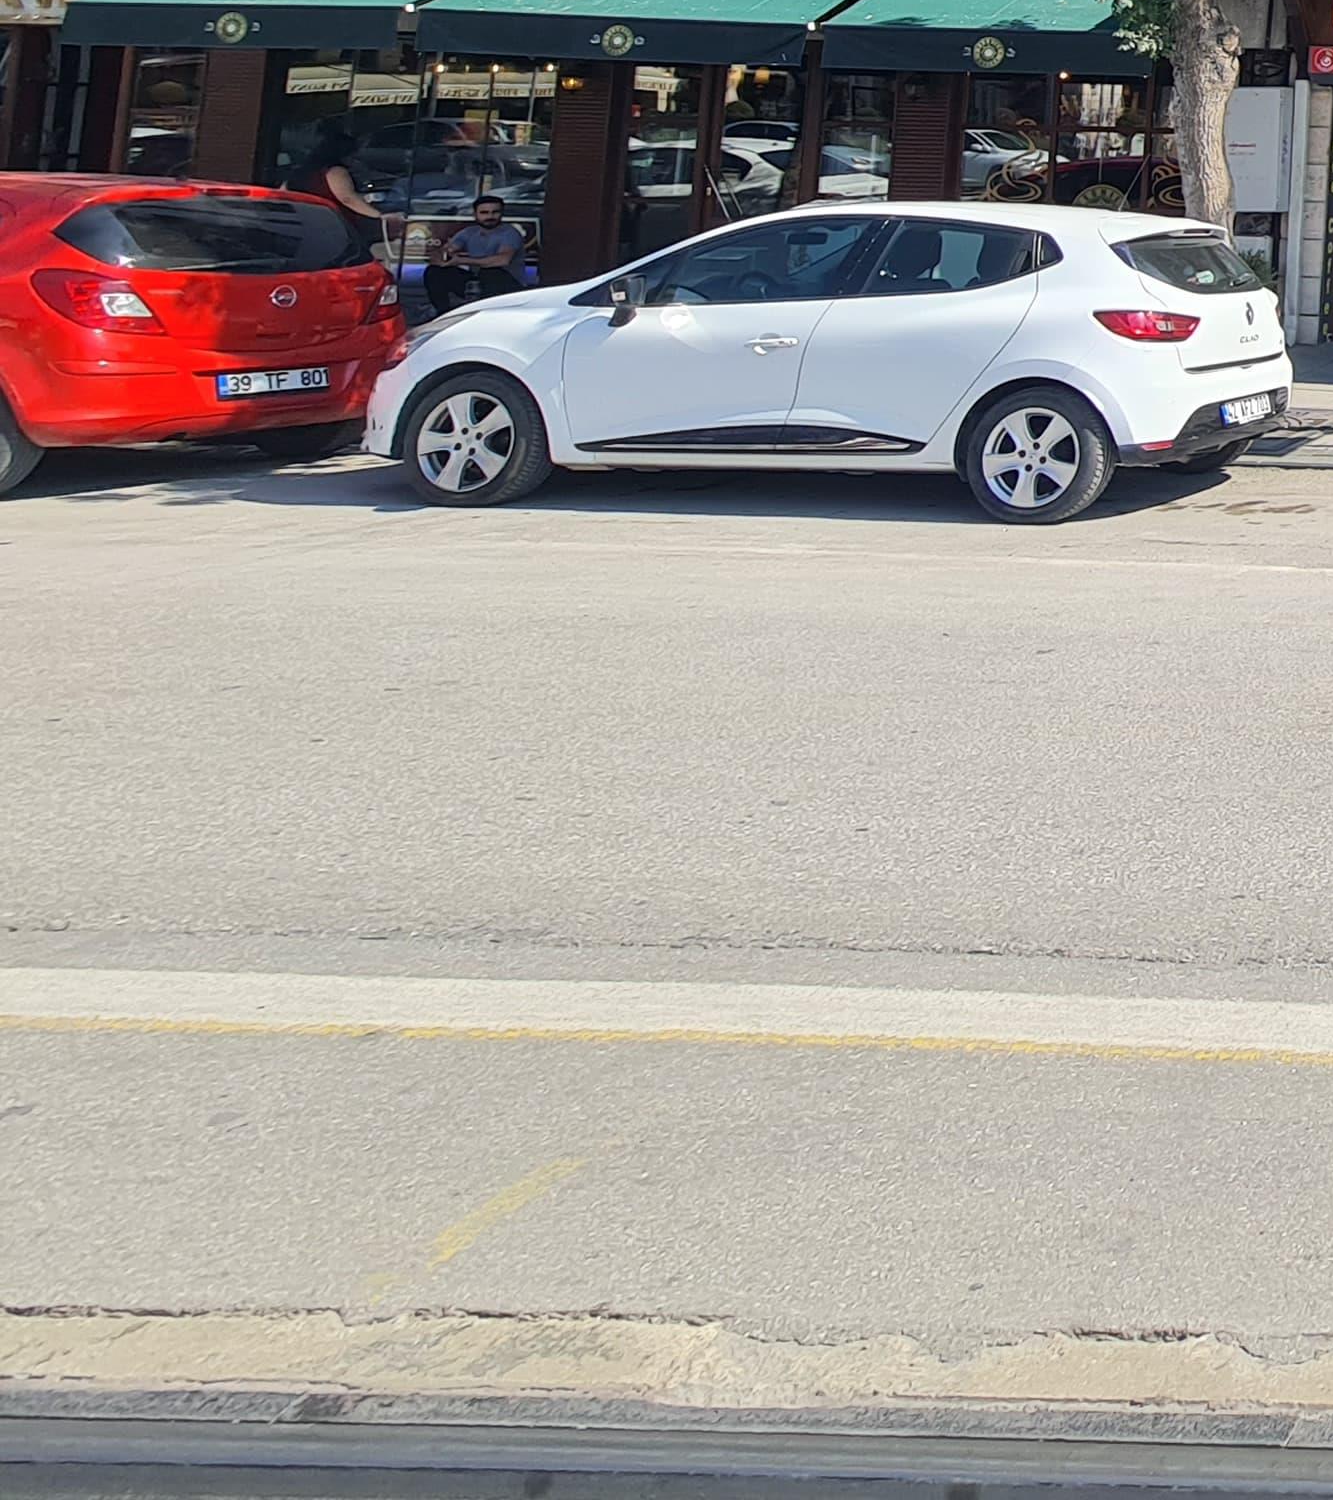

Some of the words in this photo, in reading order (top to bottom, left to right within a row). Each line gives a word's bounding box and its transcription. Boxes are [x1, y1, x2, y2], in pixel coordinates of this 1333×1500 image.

[229, 375, 252, 393] 39
[264, 371, 289, 390] TF
[300, 368, 330, 387] 801
